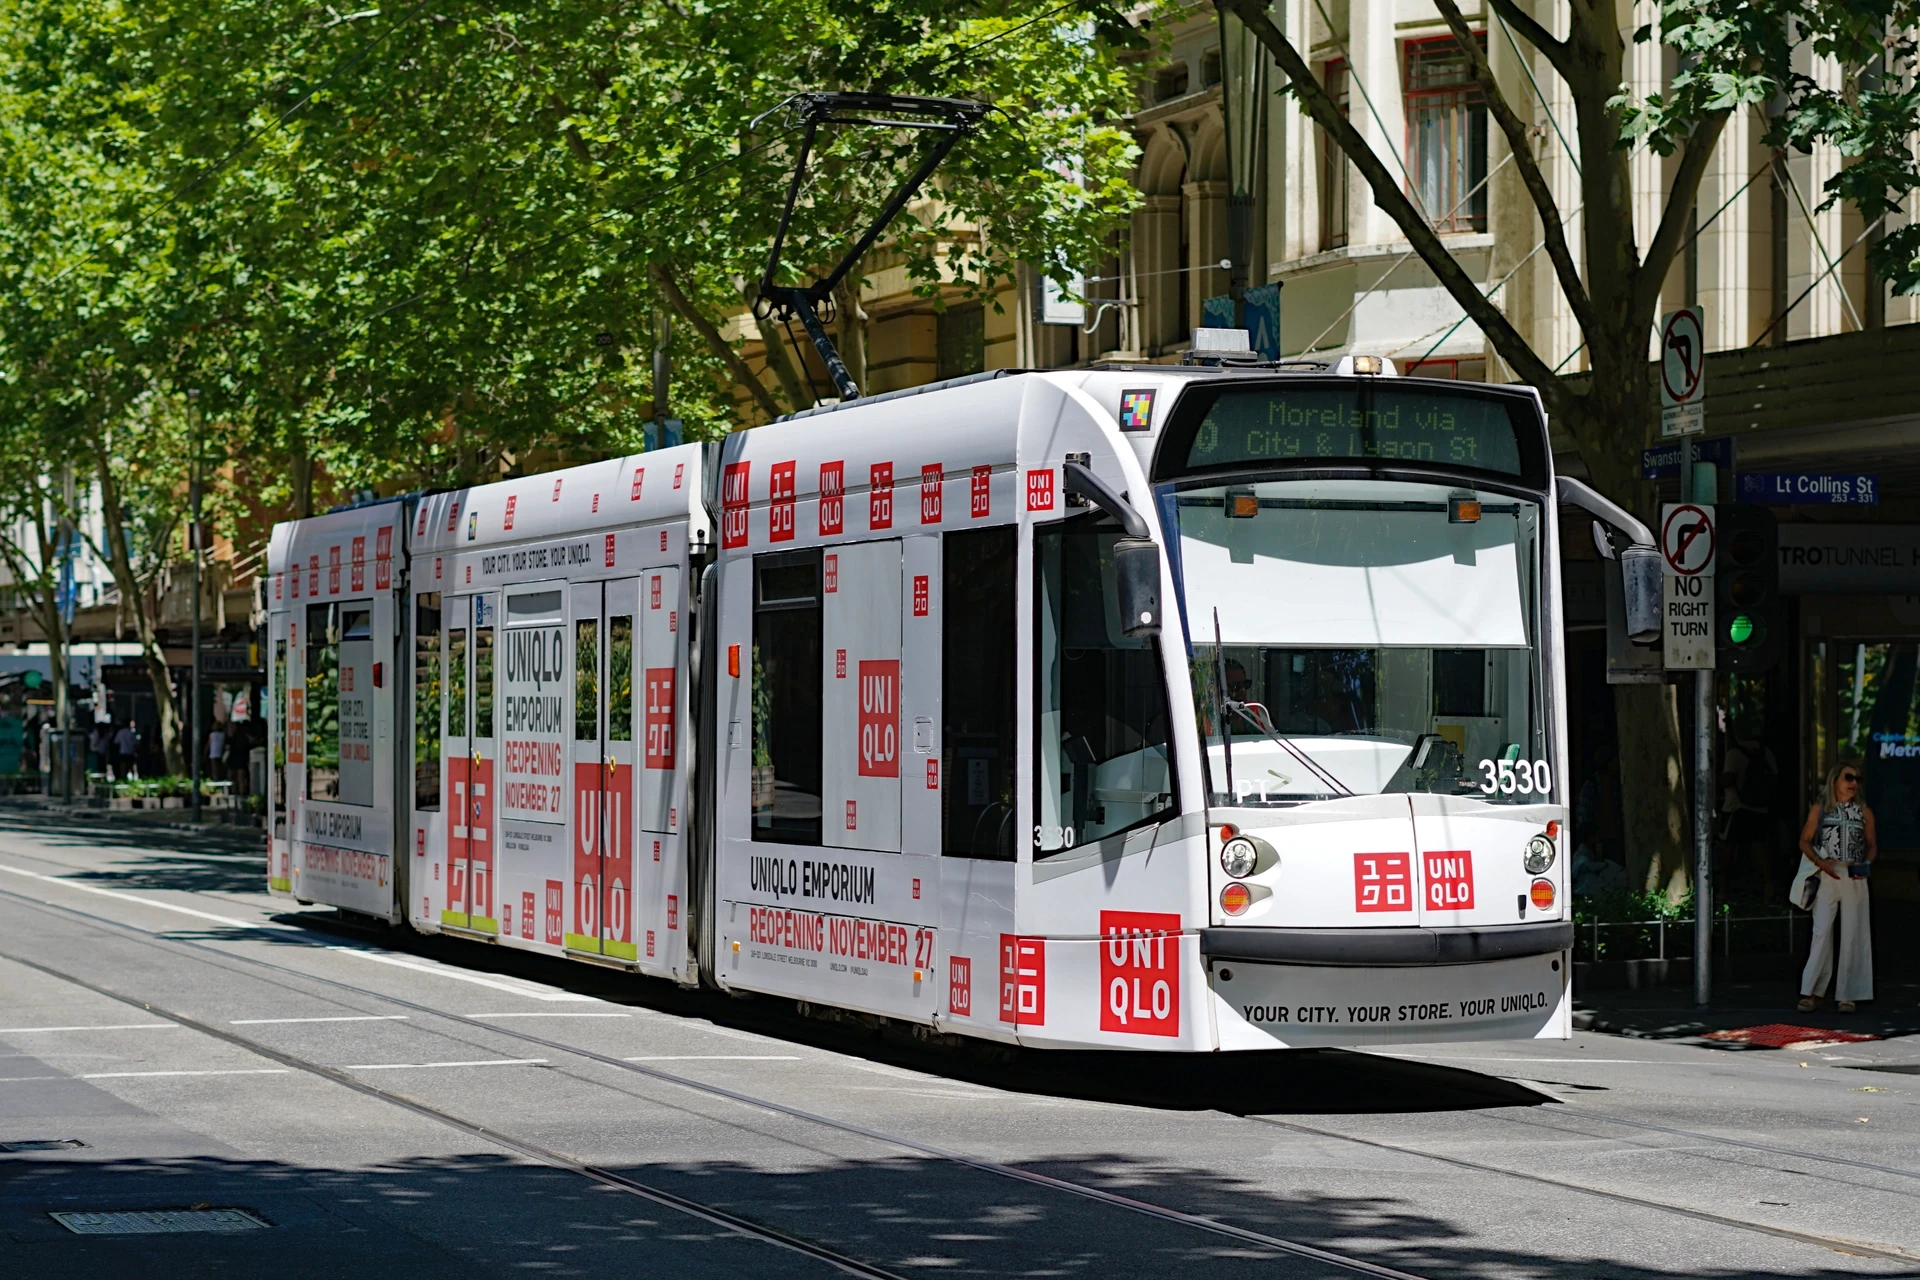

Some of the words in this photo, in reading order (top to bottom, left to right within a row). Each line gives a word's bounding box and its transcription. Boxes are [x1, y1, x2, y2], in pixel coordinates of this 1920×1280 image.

[1269, 402, 1399, 429] Moreland
[1416, 406, 1455, 430] via
[1247, 430, 1300, 456] City
[1316, 432, 1332, 456] &
[1348, 434, 1434, 459] Lygon
[1450, 436, 1477, 460] St
[1644, 450, 1682, 469] Swansto
[1691, 444, 1701, 461] St
[725, 473, 746, 501] UNI
[821, 471, 841, 493] UNI
[923, 473, 941, 491] UNI
[1030, 474, 1051, 489] UNI
[1776, 476, 1791, 493] Lt
[1798, 476, 1850, 493] Collins
[1857, 477, 1872, 494] St
[923, 496, 940, 517] QLO
[1030, 492, 1052, 508] QLO
[1831, 494, 1847, 503] 253
[1858, 494, 1873, 503] 331
[724, 509, 747, 541] QLO
[821, 501, 841, 529] QLO
[482, 556, 495, 575] YOUR
[512, 551, 526, 571] YOUR
[551, 546, 565, 567] YOUR
[826, 559, 837, 573] UNI
[1778, 547, 1904, 566] TROTUNNEL
[826, 575, 837, 591] QLO
[1675, 577, 1702, 597] NO
[1669, 602, 1708, 617] RIGHT
[1671, 622, 1708, 636] TURN
[506, 629, 562, 692] UNIQLO
[863, 675, 892, 714] UNI
[506, 696, 562, 733] EMPORIUM
[505, 741, 561, 776] REOPENING
[863, 723, 895, 769] QLO
[1880, 742, 1920, 757] Metr
[1479, 759, 1551, 794] 3530
[505, 782, 547, 812] NOVEMBER
[550, 786, 560, 813] 27
[305, 810, 328, 839] UNIQLO
[330, 812, 362, 841] EMPORIUM
[581, 789, 621, 859] UNI
[1034, 825, 1074, 848] 330
[341, 851, 376, 881] NOVEMBER
[379, 857, 387, 883] 27
[751, 856, 797, 900] UNIQLO
[803, 861, 874, 904] EMPORIUM
[1362, 859, 1404, 879] ユニ
[1429, 857, 1466, 879] UNI
[547, 888, 561, 911] UNI
[1362, 884, 1405, 905] クロ
[1431, 882, 1469, 905] QLO
[580, 873, 625, 942] QLO
[547, 914, 562, 940] QLO
[751, 908, 823, 952] REOPENING
[830, 918, 908, 966] NOVEMBER
[915, 930, 933, 969] 27
[1003, 945, 1037, 976] ユニ
[1109, 926, 1165, 969] UNI
[952, 966, 968, 983] UNI
[951, 988, 969, 1010] QLO
[1003, 983, 1037, 1014] クロ
[1110, 977, 1170, 1024] QLO
[1243, 1005, 1289, 1023] YOUR
[1297, 1005, 1339, 1023] CITY.
[1347, 1005, 1391, 1022] YOUR
[1398, 1002, 1452, 1021] STORE.
[1460, 998, 1495, 1018] YOUR
[1501, 991, 1548, 1012] UNIQLO.
